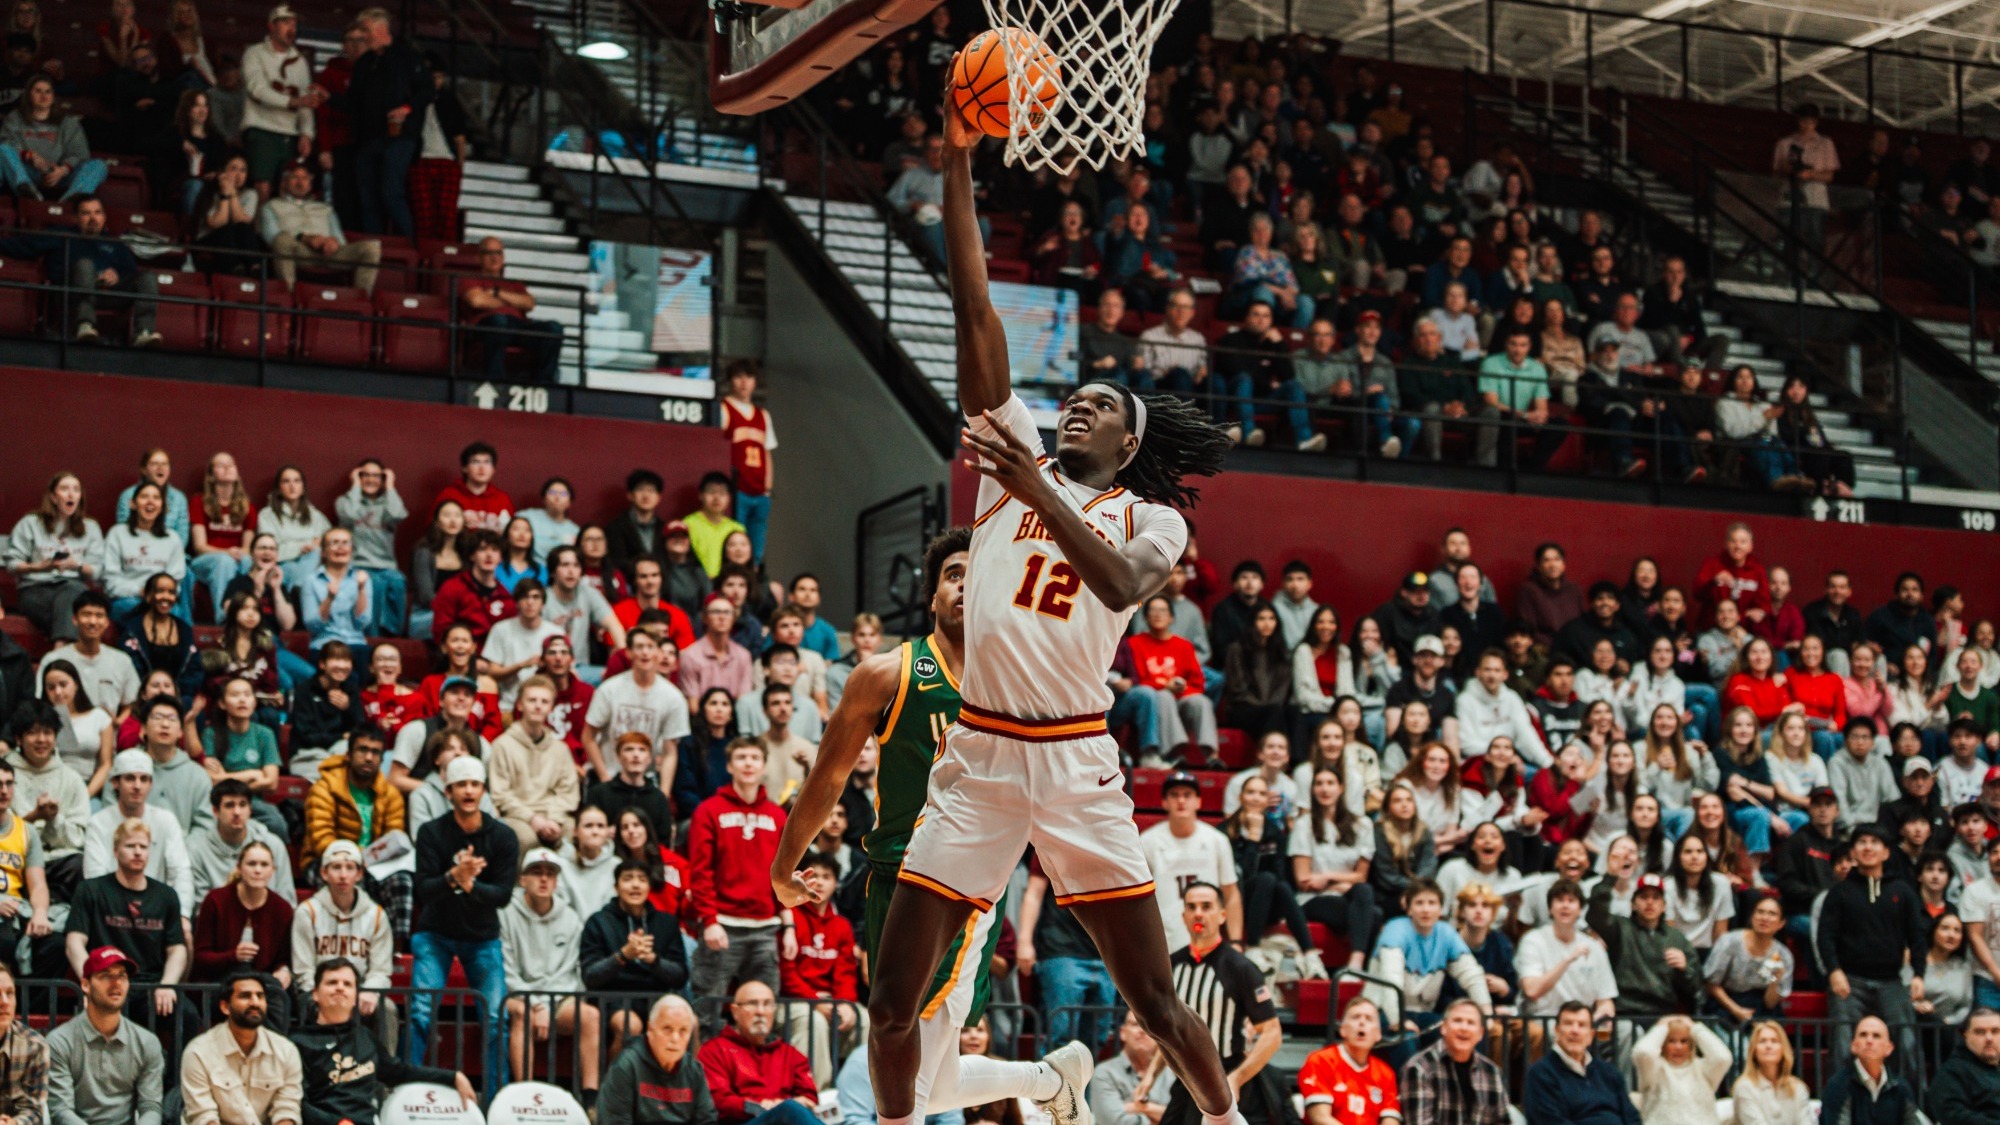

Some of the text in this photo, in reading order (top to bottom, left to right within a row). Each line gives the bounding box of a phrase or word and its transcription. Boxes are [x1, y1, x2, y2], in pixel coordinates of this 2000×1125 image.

[508, 385, 548, 413] 210
[660, 399, 703, 424] 108
[1838, 500, 1866, 524] 211
[1962, 510, 1996, 531] 109
[1012, 552, 1080, 622] 12
[917, 661, 936, 673] LW
[403, 1104, 463, 1114] SANTA CLARA
[512, 1105, 569, 1116] SANTA CLARA
